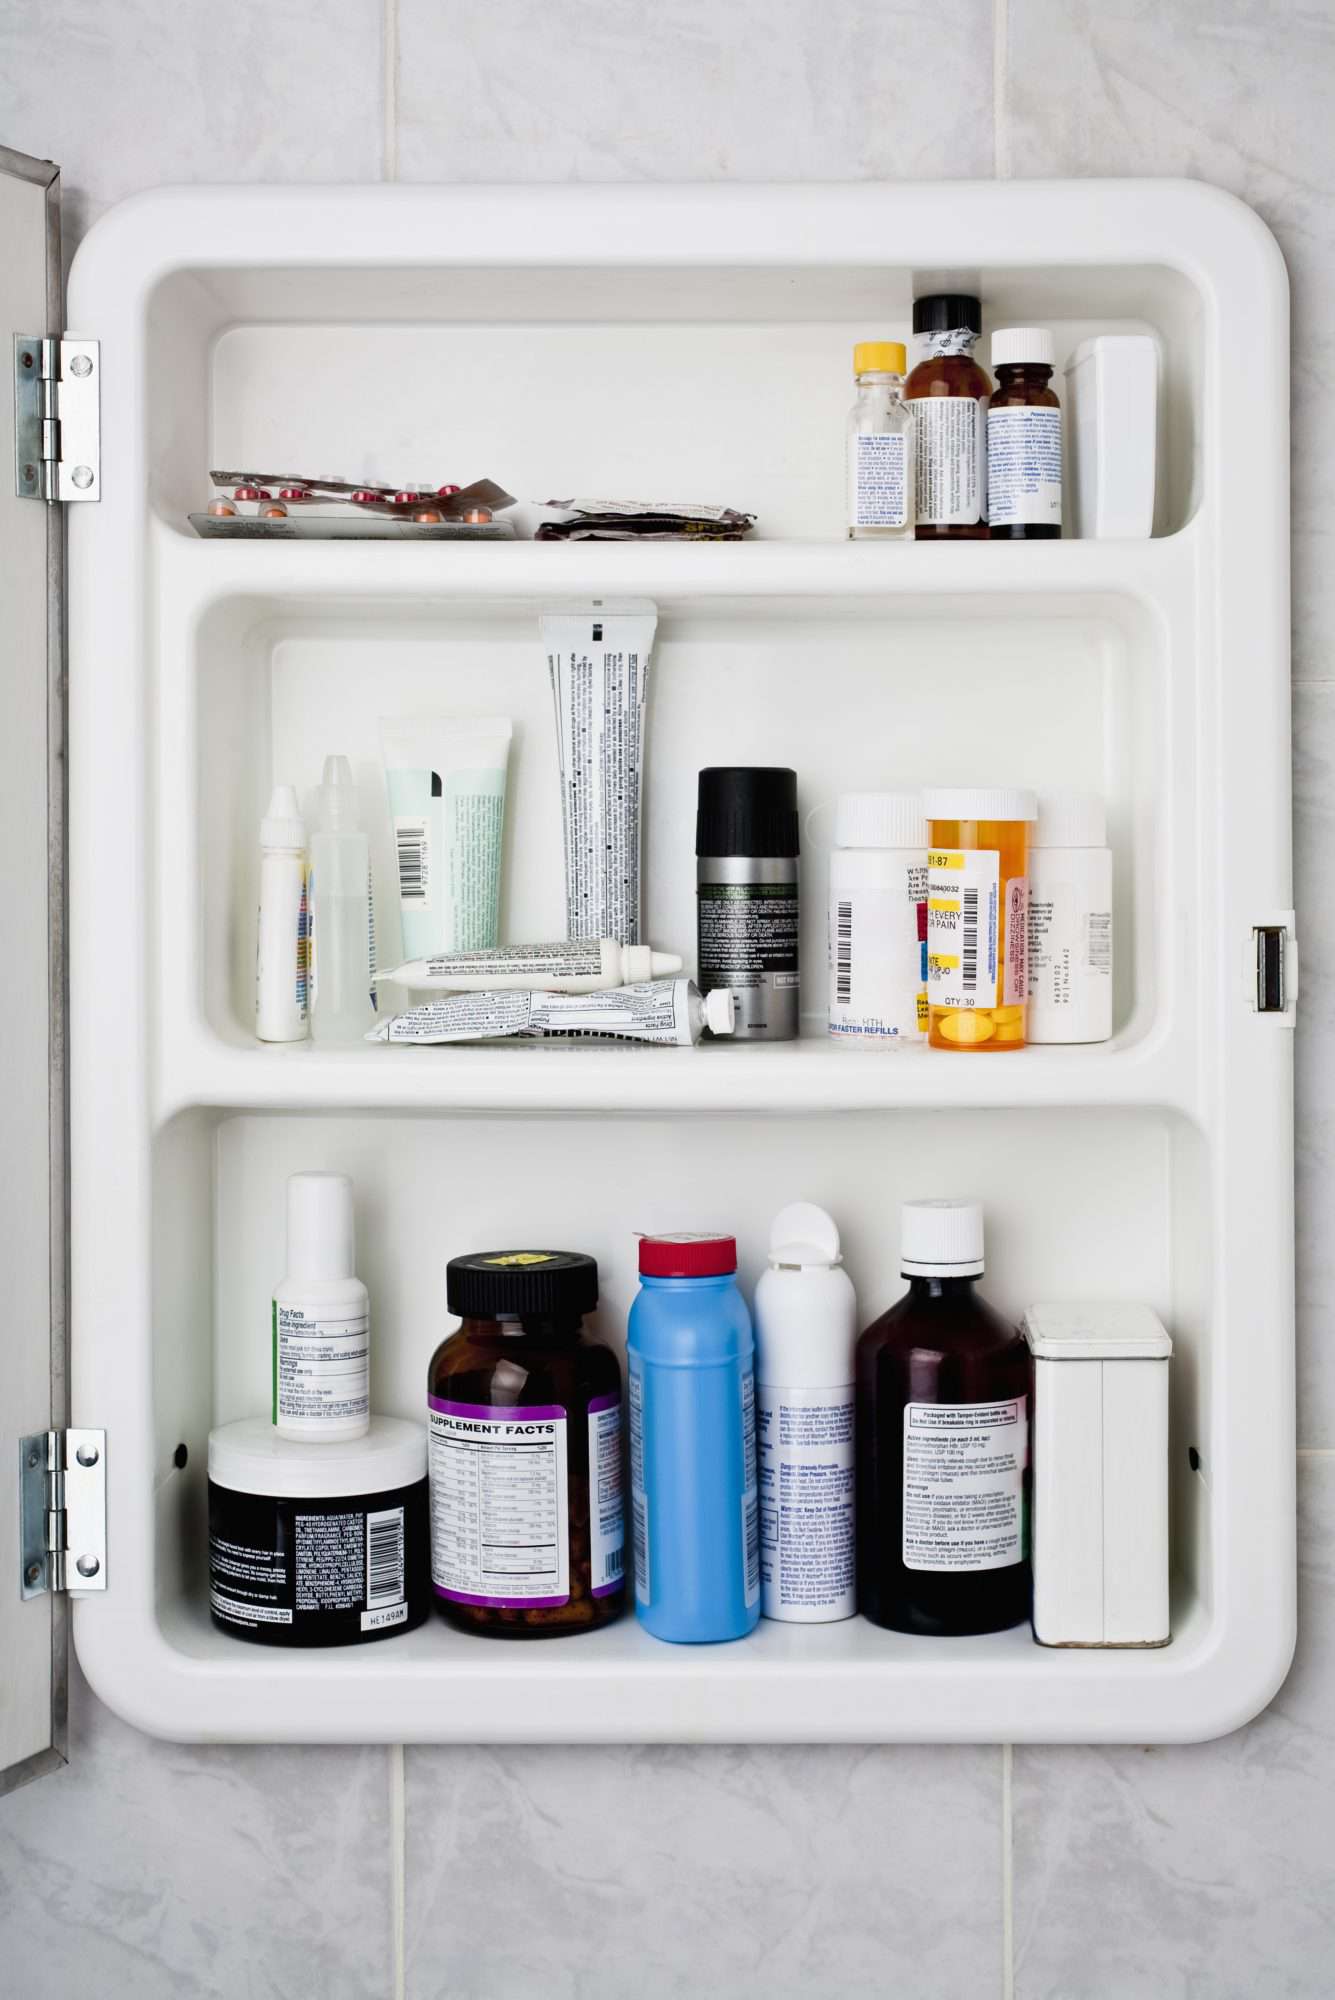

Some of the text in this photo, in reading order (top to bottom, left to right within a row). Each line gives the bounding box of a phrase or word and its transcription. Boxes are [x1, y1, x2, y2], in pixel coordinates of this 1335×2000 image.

[935, 911, 962, 921] EVERY
[936, 920, 956, 930] PAIN
[945, 997, 960, 1005] QTY
[838, 1024, 863, 1033] FASTER
[864, 1026, 899, 1035] REFILLS
[290, 1309, 304, 1319] Facts
[430, 1414, 555, 1435] SUPPLEMENT FACTS
